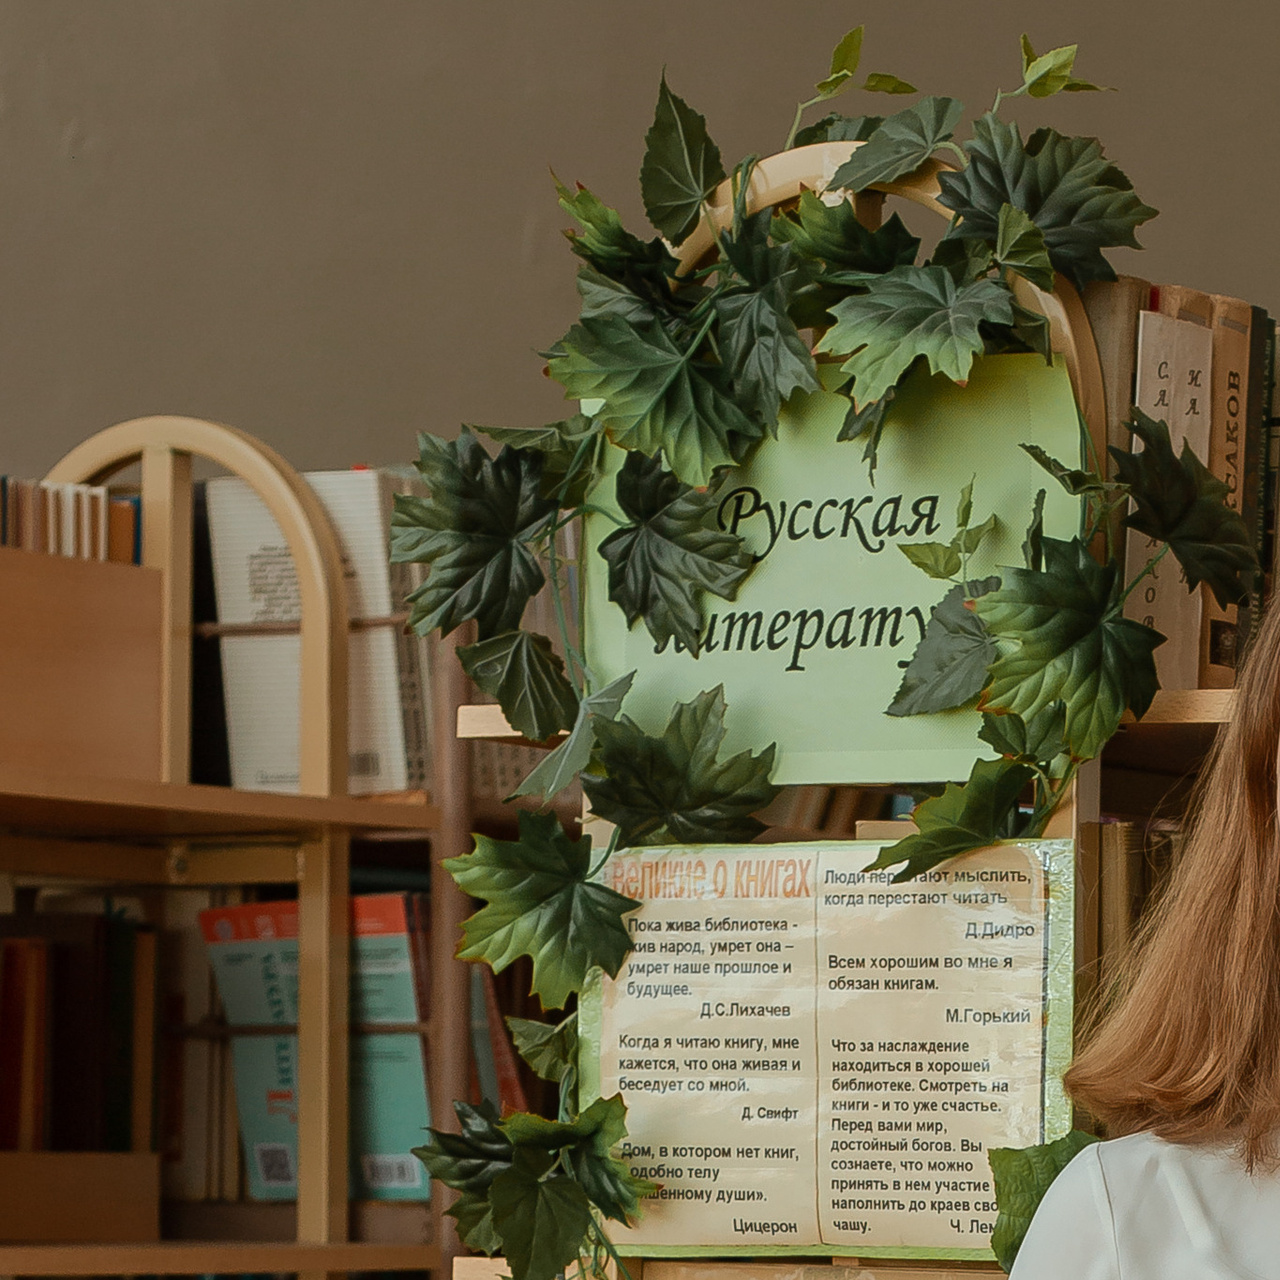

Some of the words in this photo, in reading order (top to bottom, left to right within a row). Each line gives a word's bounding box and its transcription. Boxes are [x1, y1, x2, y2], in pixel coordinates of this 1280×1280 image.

[1225, 370, 1241, 509] САКОВ
[717, 486, 941, 563] Русская
[655, 605, 937, 672] итерату
[712, 859, 728, 898] о
[734, 858, 811, 898] книгах
[823, 868, 866, 886] Люди
[868, 870, 951, 887] перают
[954, 869, 1032, 885] мыслить,
[824, 893, 865, 908] когда
[867, 892, 949, 909] перестают
[952, 892, 1008, 909] читать
[628, 917, 663, 933] Пока
[665, 920, 702, 933] жива
[704, 917, 789, 932] библиотека
[964, 920, 1037, 940] Д.Дидро
[659, 941, 705, 957] народ,
[709, 941, 753, 957] умрет
[755, 941, 782, 953] она
[627, 962, 671, 978] умрет
[673, 962, 711, 975] наше
[714, 962, 780, 978] прошлое
[782, 962, 792, 974] и
[828, 954, 866, 970] Всем
[869, 957, 940, 972] хорошим
[943, 957, 964, 969] во
[967, 956, 999, 969] мне
[1000, 956, 1013, 969] я
[626, 981, 693, 999] будущее.
[828, 975, 880, 991] обязан
[883, 978, 939, 991] книгам.
[699, 1002, 791, 1020] Д.С.Лихачев
[945, 1008, 1031, 1027] М.Горький
[619, 1034, 660, 1051] Когда
[662, 1037, 672, 1049] я
[675, 1037, 721, 1049] читаю
[724, 1037, 768, 1053] книгу,
[771, 1037, 800, 1050] мне
[831, 1038, 857, 1053] Что
[859, 1041, 875, 1053] за
[877, 1041, 970, 1055] наслаждение
[618, 1058, 680, 1073] кажется,
[683, 1059, 709, 1071] что
[711, 1059, 738, 1071] она
[741, 1059, 788, 1072] живая
[791, 1059, 801, 1072] и
[831, 1060, 912, 1075] находиться
[914, 1061, 924, 1073] в
[926, 1058, 991, 1076] хорошей
[617, 1076, 685, 1095] беседует
[687, 1080, 705, 1092] со
[709, 1077, 750, 1092] мной.
[831, 1077, 916, 1092] библиотеке.
[918, 1078, 988, 1096] Смотреть
[991, 1081, 1009, 1093] на
[741, 1106, 755, 1122] Д.
[756, 1106, 799, 1122] Свифт
[831, 1100, 870, 1112] книги
[881, 1100, 891, 1112] и
[892, 1100, 910, 1112] то
[912, 1100, 939, 1116] уже
[941, 1100, 1002, 1113] счастье.
[831, 1117, 874, 1135] Перед
[877, 1120, 913, 1132] вами
[915, 1121, 948, 1136] мир,
[620, 1142, 656, 1160] Дом,
[658, 1146, 669, 1158] в
[672, 1146, 732, 1162] котором
[736, 1147, 761, 1159] нет
[764, 1147, 799, 1162] книг,
[830, 1137, 909, 1153] достойный
[911, 1137, 957, 1153] богов.
[960, 1138, 983, 1153] Вы
[630, 1163, 684, 1182] одобно
[686, 1167, 720, 1182] телу
[830, 1159, 897, 1174] сознаете,
[899, 1160, 924, 1172] что
[927, 1160, 974, 1173] можно
[643, 1187, 713, 1205] шенному
[715, 1189, 768, 1205] души».
[830, 1179, 889, 1194] принять
[892, 1179, 902, 1191] в
[904, 1179, 931, 1192] нем
[934, 1180, 990, 1195] участие
[831, 1198, 906, 1211] наполнить
[908, 1199, 927, 1213] до
[929, 1200, 971, 1215] краев
[973, 1199, 1000, 1213] сво
[732, 1217, 798, 1236] Цицерон
[832, 1220, 872, 1235] чашу.
[949, 1218, 965, 1234] Ч.
